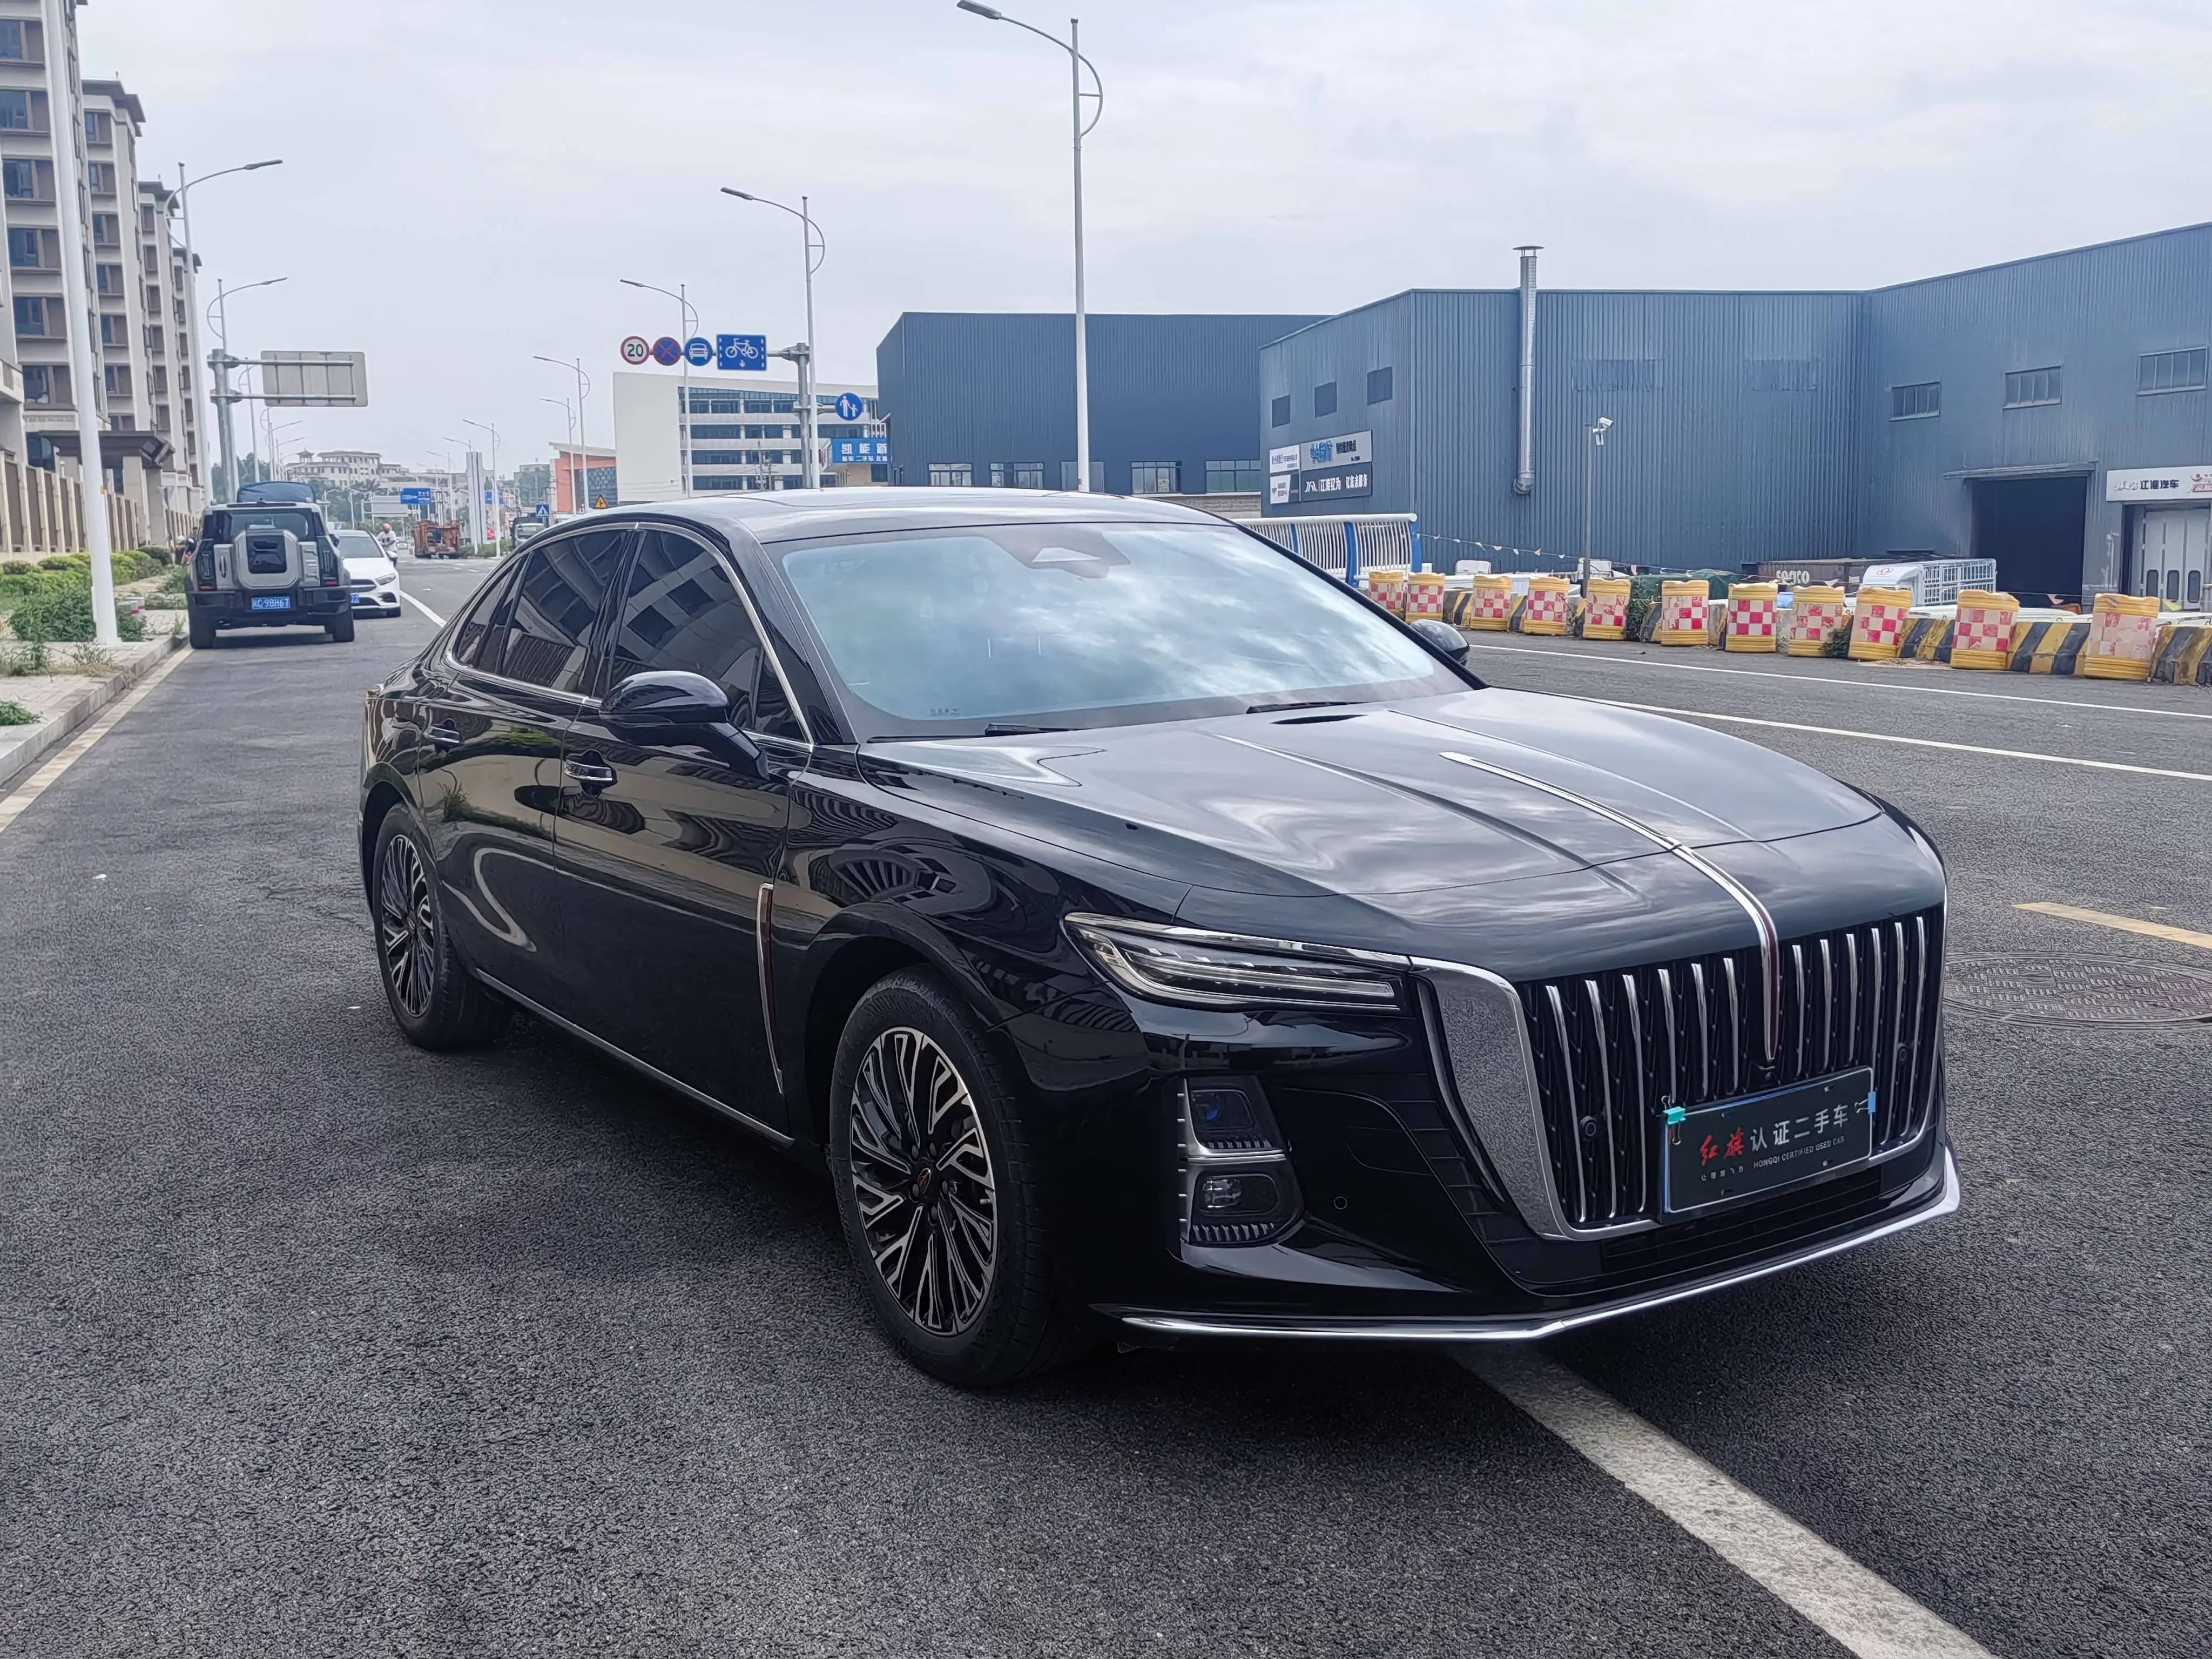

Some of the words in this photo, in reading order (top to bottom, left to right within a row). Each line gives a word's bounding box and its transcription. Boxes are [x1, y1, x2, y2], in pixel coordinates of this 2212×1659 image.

[627, 343, 644, 357] 20
[2140, 479, 2180, 490] 江淮汽车
[1754, 1155, 1780, 1169] HONGQI
[1782, 1145, 1813, 1161] CERTIFIED
[1815, 1140, 1831, 1151] USED
[1832, 1136, 1845, 1145] CAR
